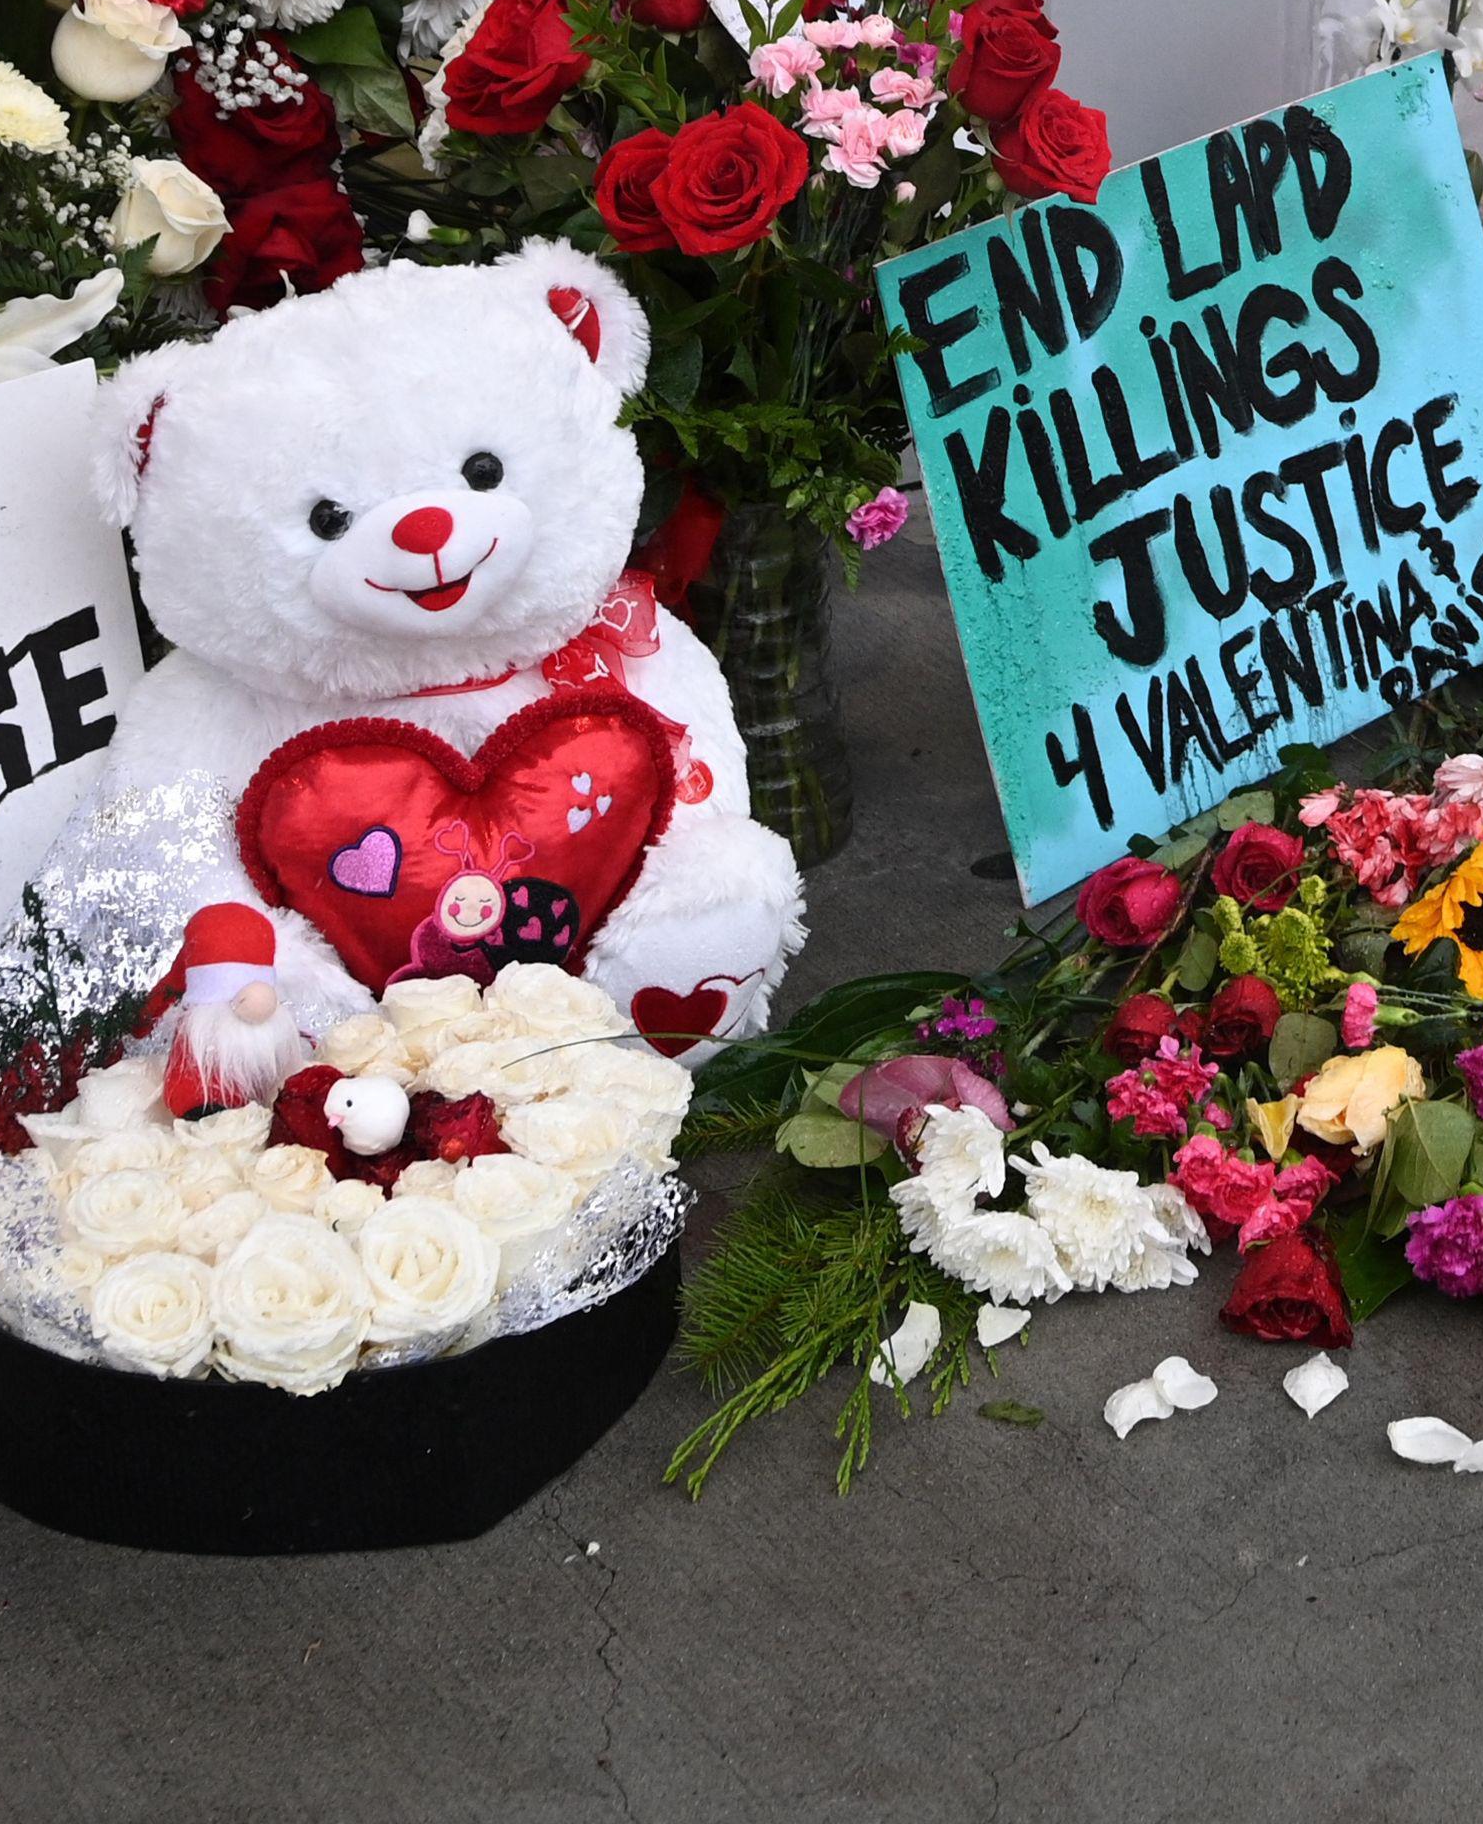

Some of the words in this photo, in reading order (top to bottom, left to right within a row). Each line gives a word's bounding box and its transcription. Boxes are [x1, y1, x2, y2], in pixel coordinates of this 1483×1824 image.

[899, 202, 1123, 418] END
[1141, 105, 1353, 300] LAPD
[1045, 701, 1115, 831] 4
